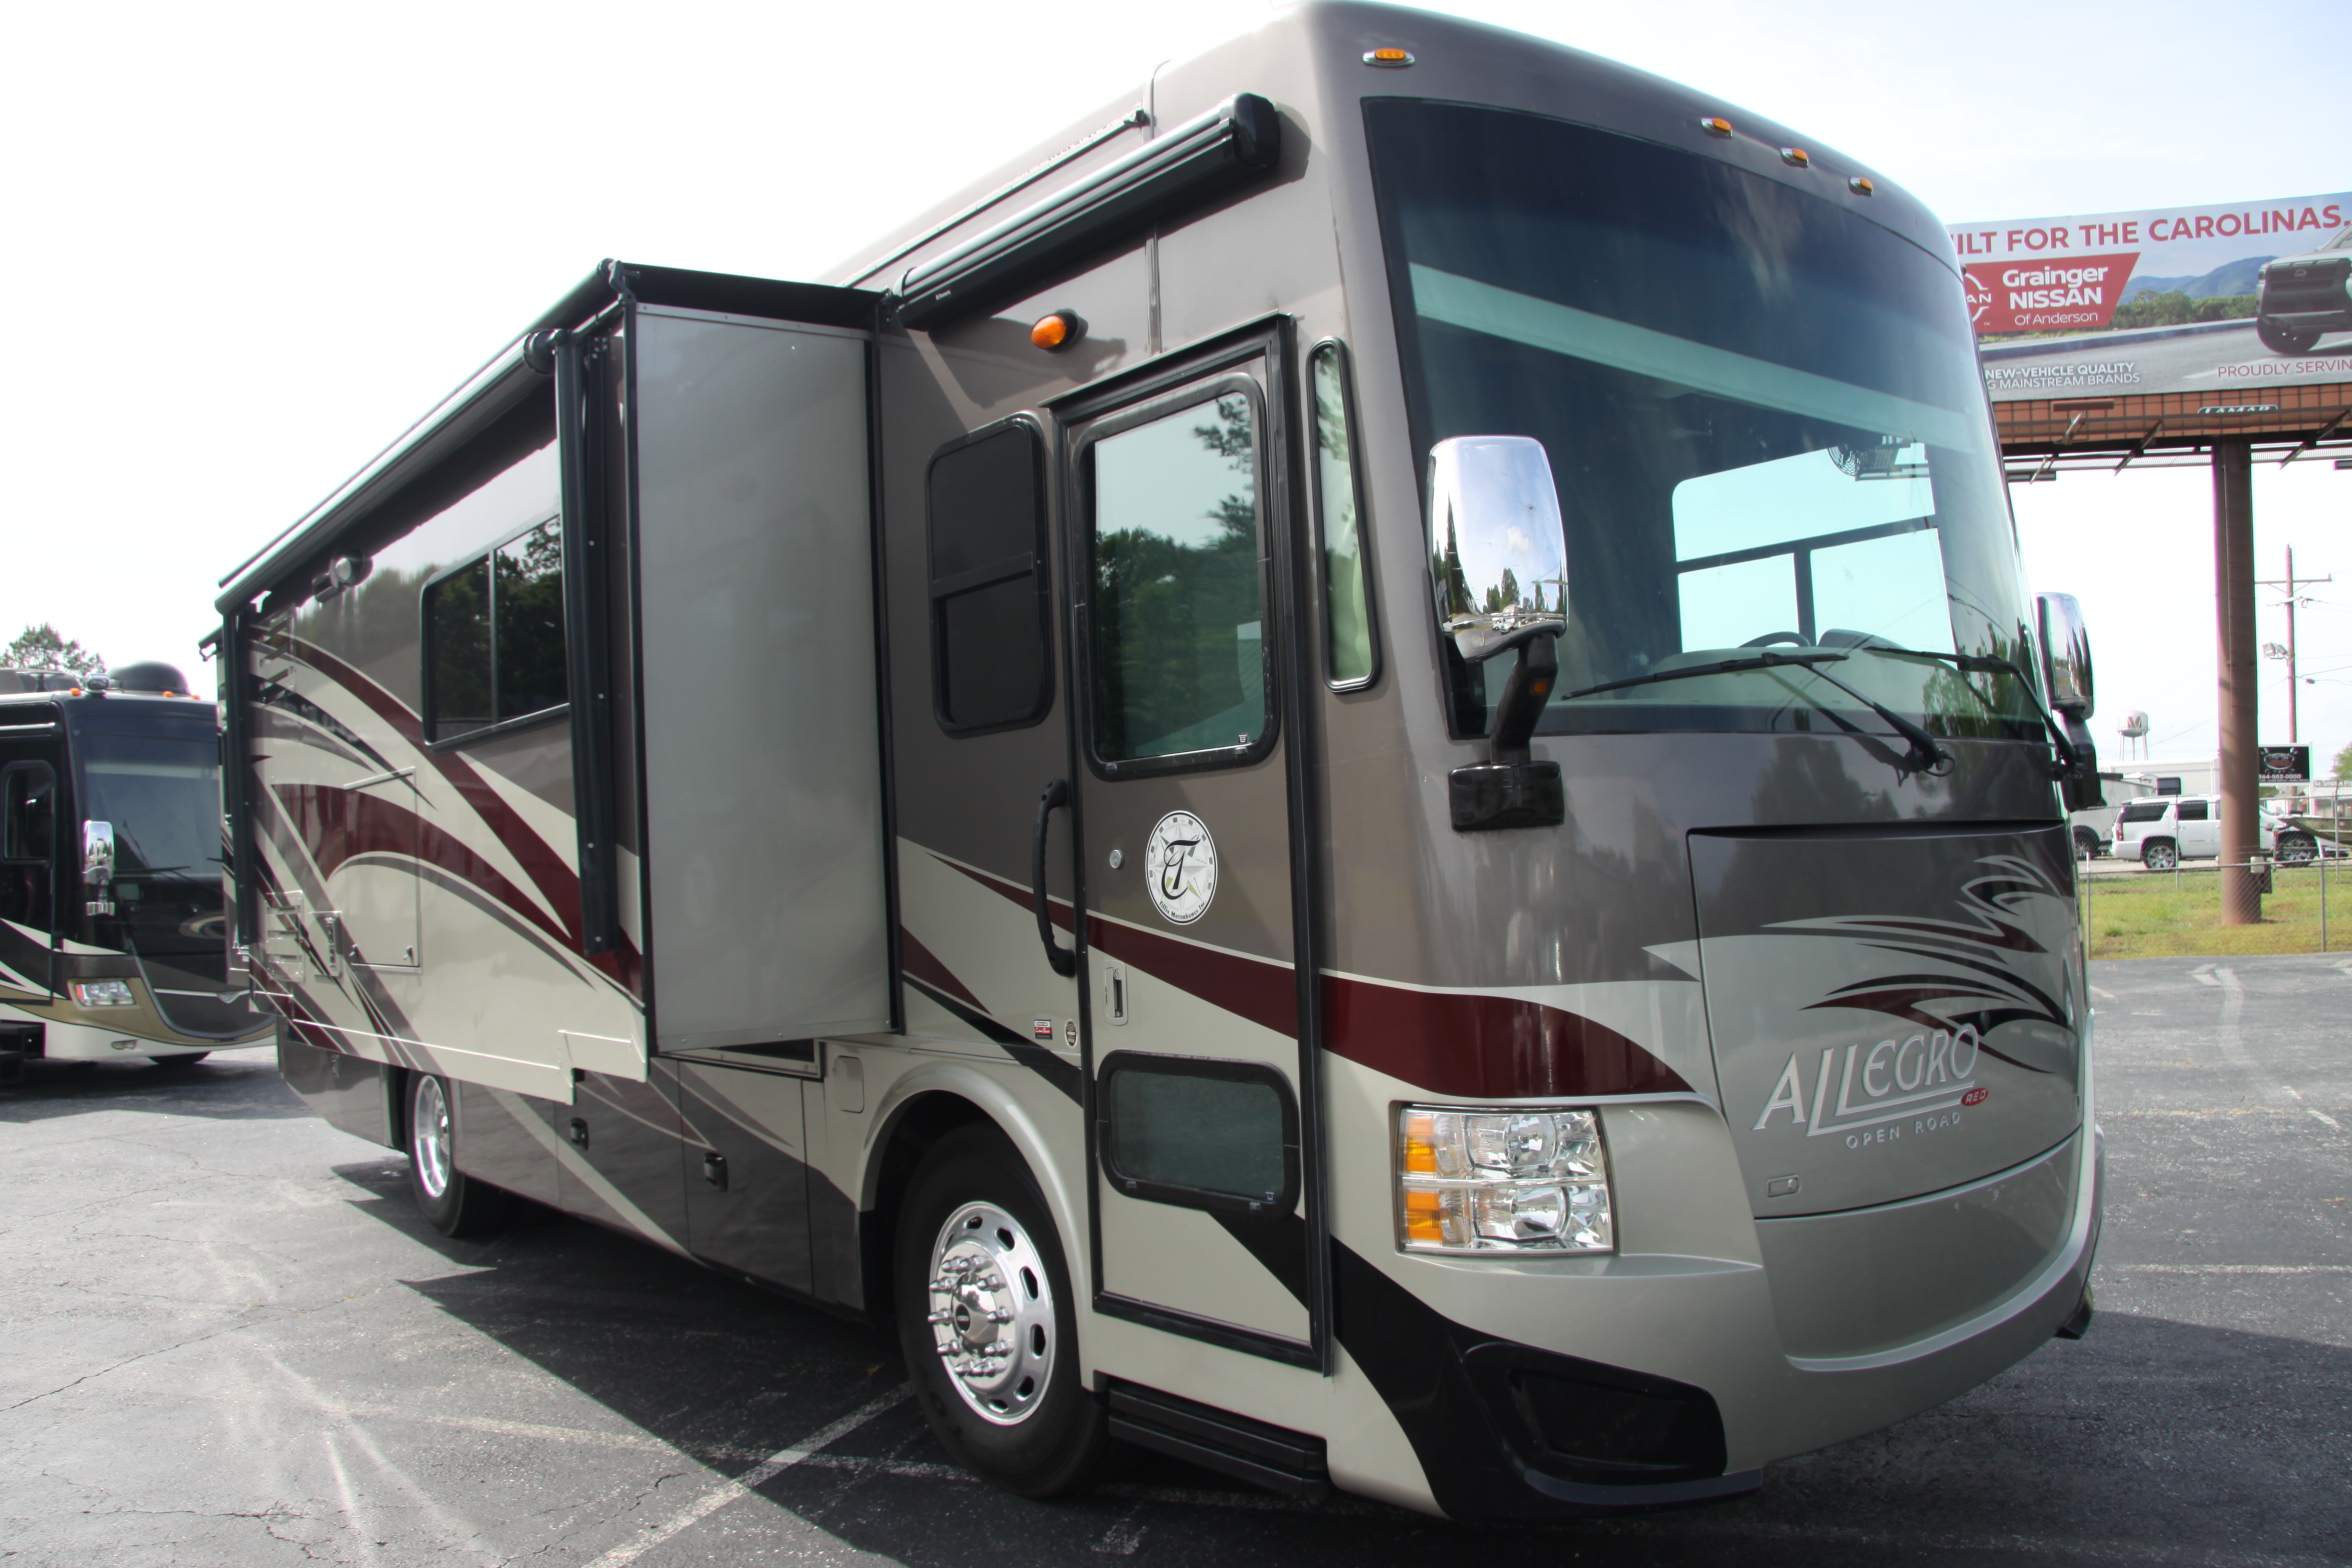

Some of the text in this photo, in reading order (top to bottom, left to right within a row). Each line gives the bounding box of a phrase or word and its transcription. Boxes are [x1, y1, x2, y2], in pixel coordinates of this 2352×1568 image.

[1951, 204, 2351, 255] ILT FOR THE CAROLINAS.
[2002, 265, 2109, 290] Grainger
[2009, 286, 2102, 310] NISSAN
[2014, 311, 2098, 326] Of Anderson
[1985, 362, 2135, 380] NEW-VEHICLE QUALITY
[1999, 375, 2084, 389] MAINSTREAM
[2087, 373, 2140, 386] BRANDS
[2218, 363, 2291, 378] PROUDLY
[1752, 1022, 1979, 1137] ALLEGRO
[1965, 1088, 1988, 1105] RED
[1845, 1111, 1961, 1149] OPEN ROAD
